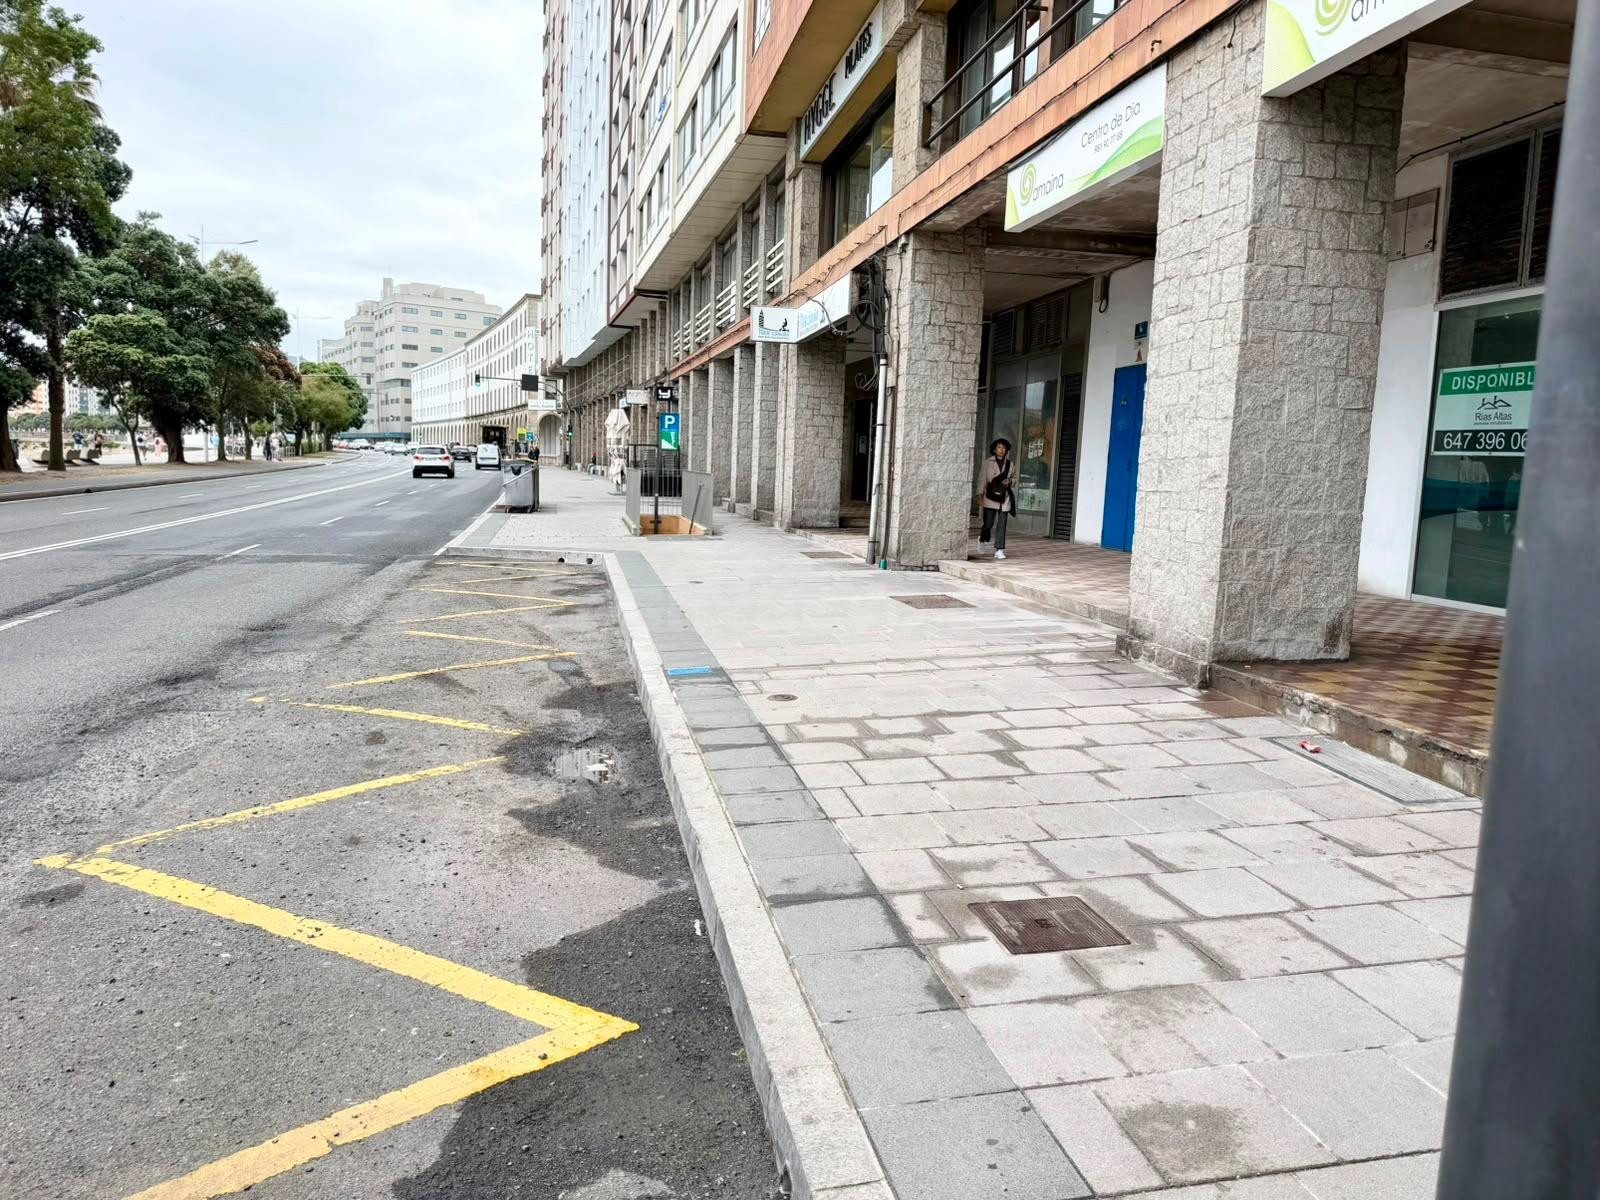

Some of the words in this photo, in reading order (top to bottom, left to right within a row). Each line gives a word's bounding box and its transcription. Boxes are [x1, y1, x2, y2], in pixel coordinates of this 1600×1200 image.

[804, 72, 836, 145] HYGGE
[845, 21, 873, 79] PILATES
[1081, 122, 1109, 148] Centro
[1110, 112, 1122, 130] de
[1032, 172, 1064, 201] amaina
[527, 329, 535, 375] HOTE
[1451, 371, 1534, 390] DISPONIBL
[664, 415, 676, 429] P
[1493, 412, 1512, 421] Altas
[1443, 432, 1472, 449] 647
[1475, 432, 1506, 449] 396
[1510, 431, 1529, 450] 06
